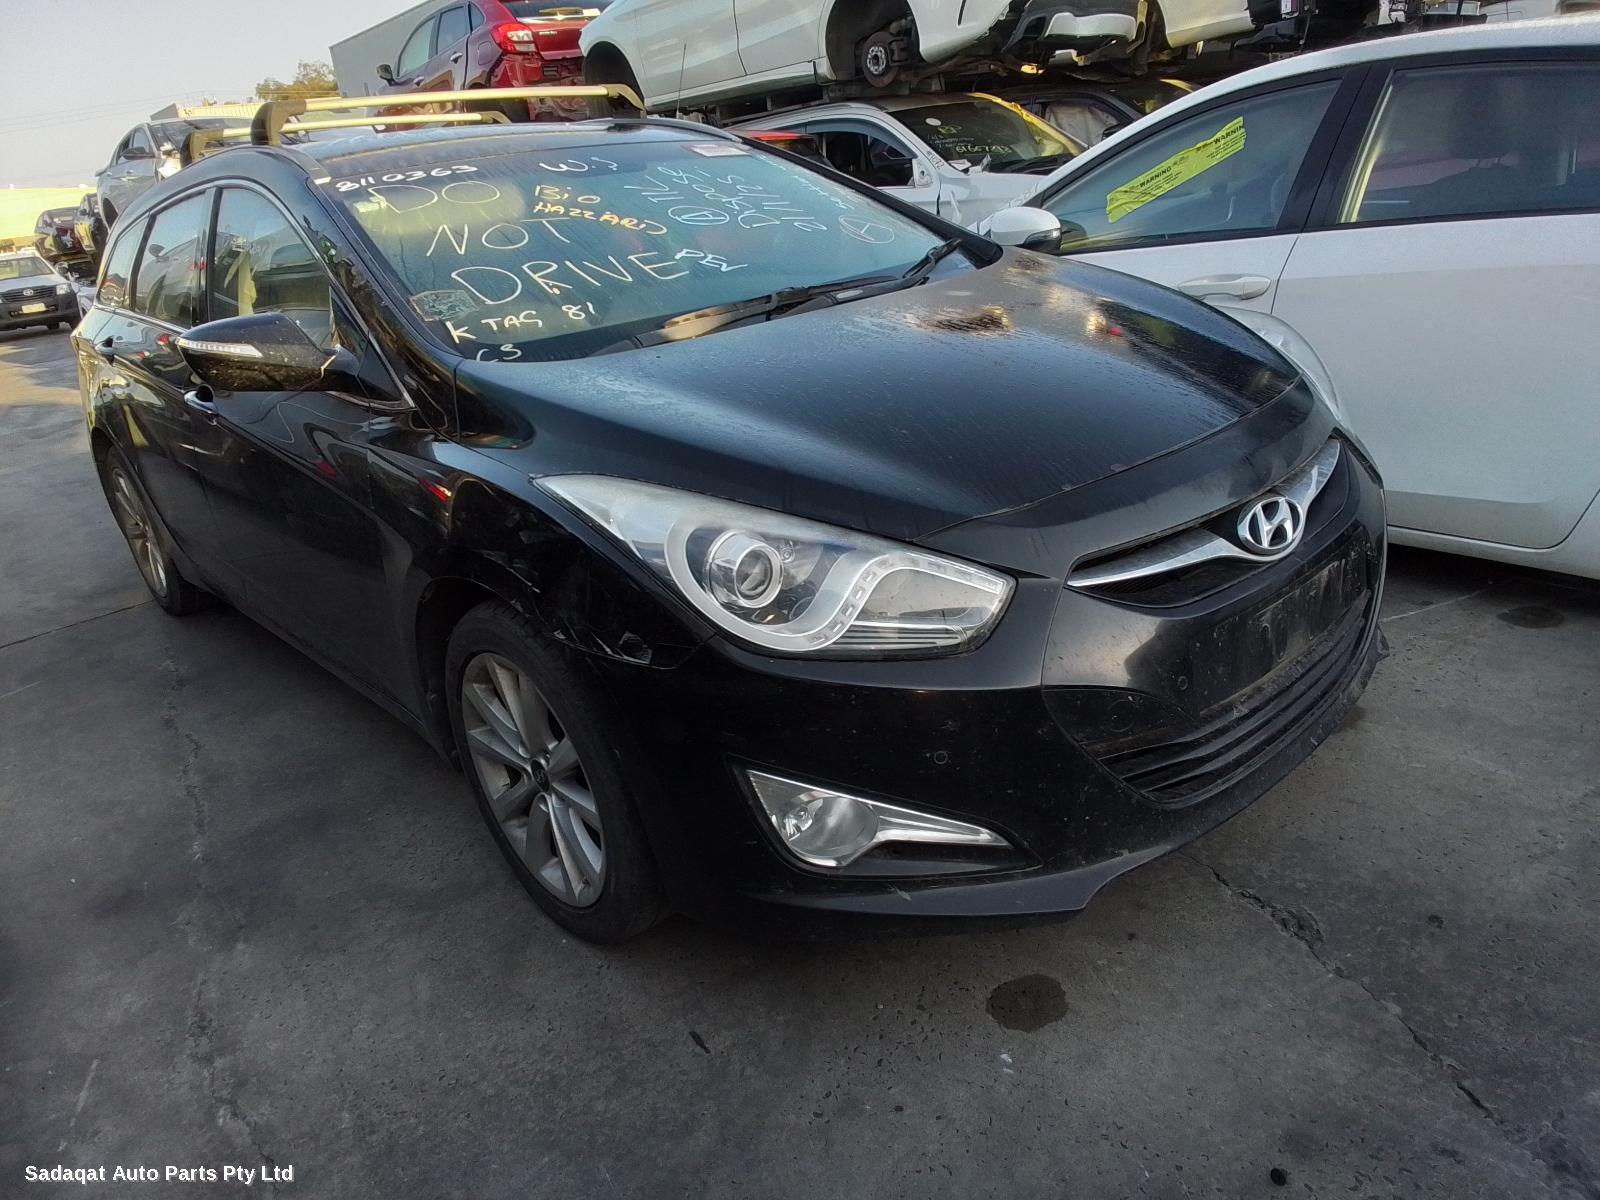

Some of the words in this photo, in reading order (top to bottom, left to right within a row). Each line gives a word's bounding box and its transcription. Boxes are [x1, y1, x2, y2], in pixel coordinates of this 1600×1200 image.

[335, 165, 478, 191] 8110363
[1140, 166, 1172, 188] WARNING
[367, 181, 501, 214] DO
[426, 217, 570, 256] NOT
[451, 252, 690, 305] DRIVE
